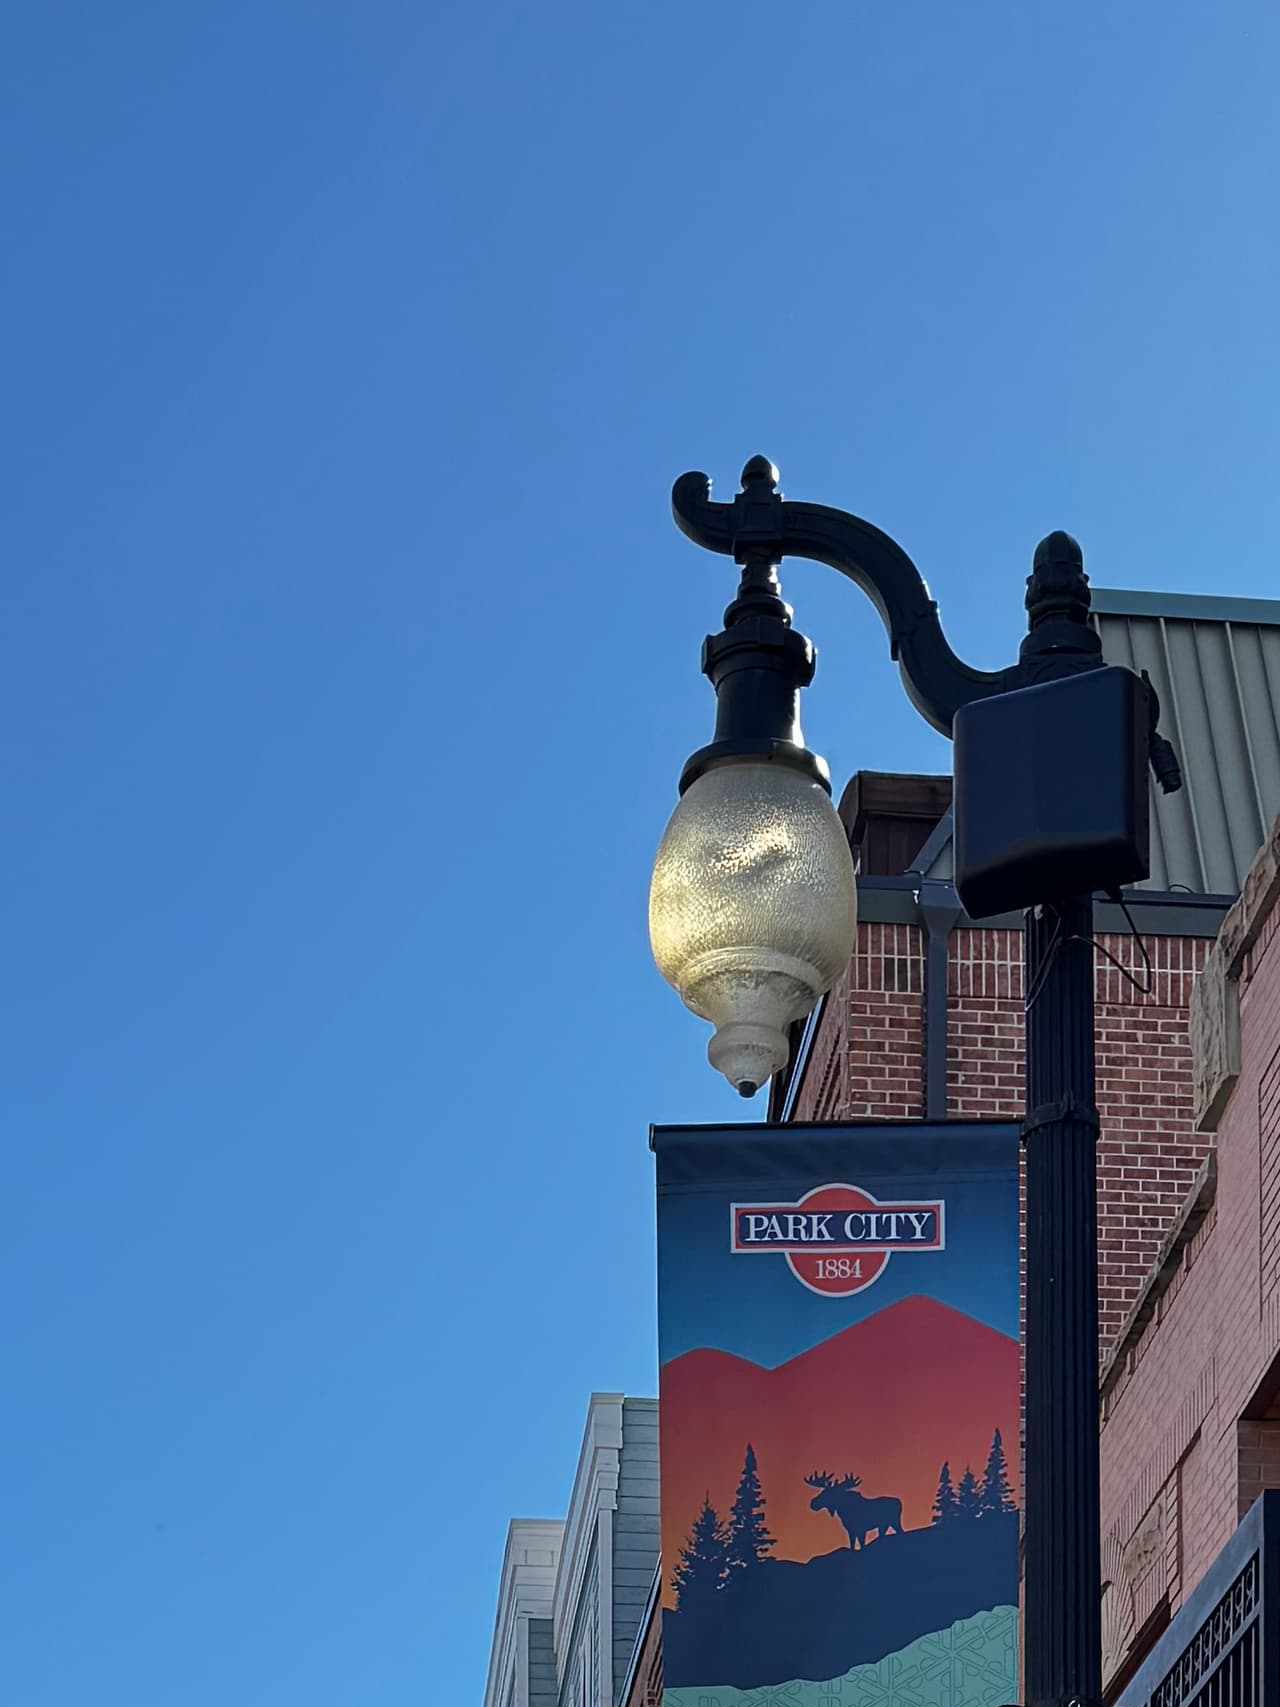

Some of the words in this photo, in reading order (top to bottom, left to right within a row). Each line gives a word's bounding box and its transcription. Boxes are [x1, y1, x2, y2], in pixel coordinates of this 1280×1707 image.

[744, 1215, 835, 1241] PARK
[844, 1213, 932, 1240] CITY
[816, 1259, 863, 1279] 1884
